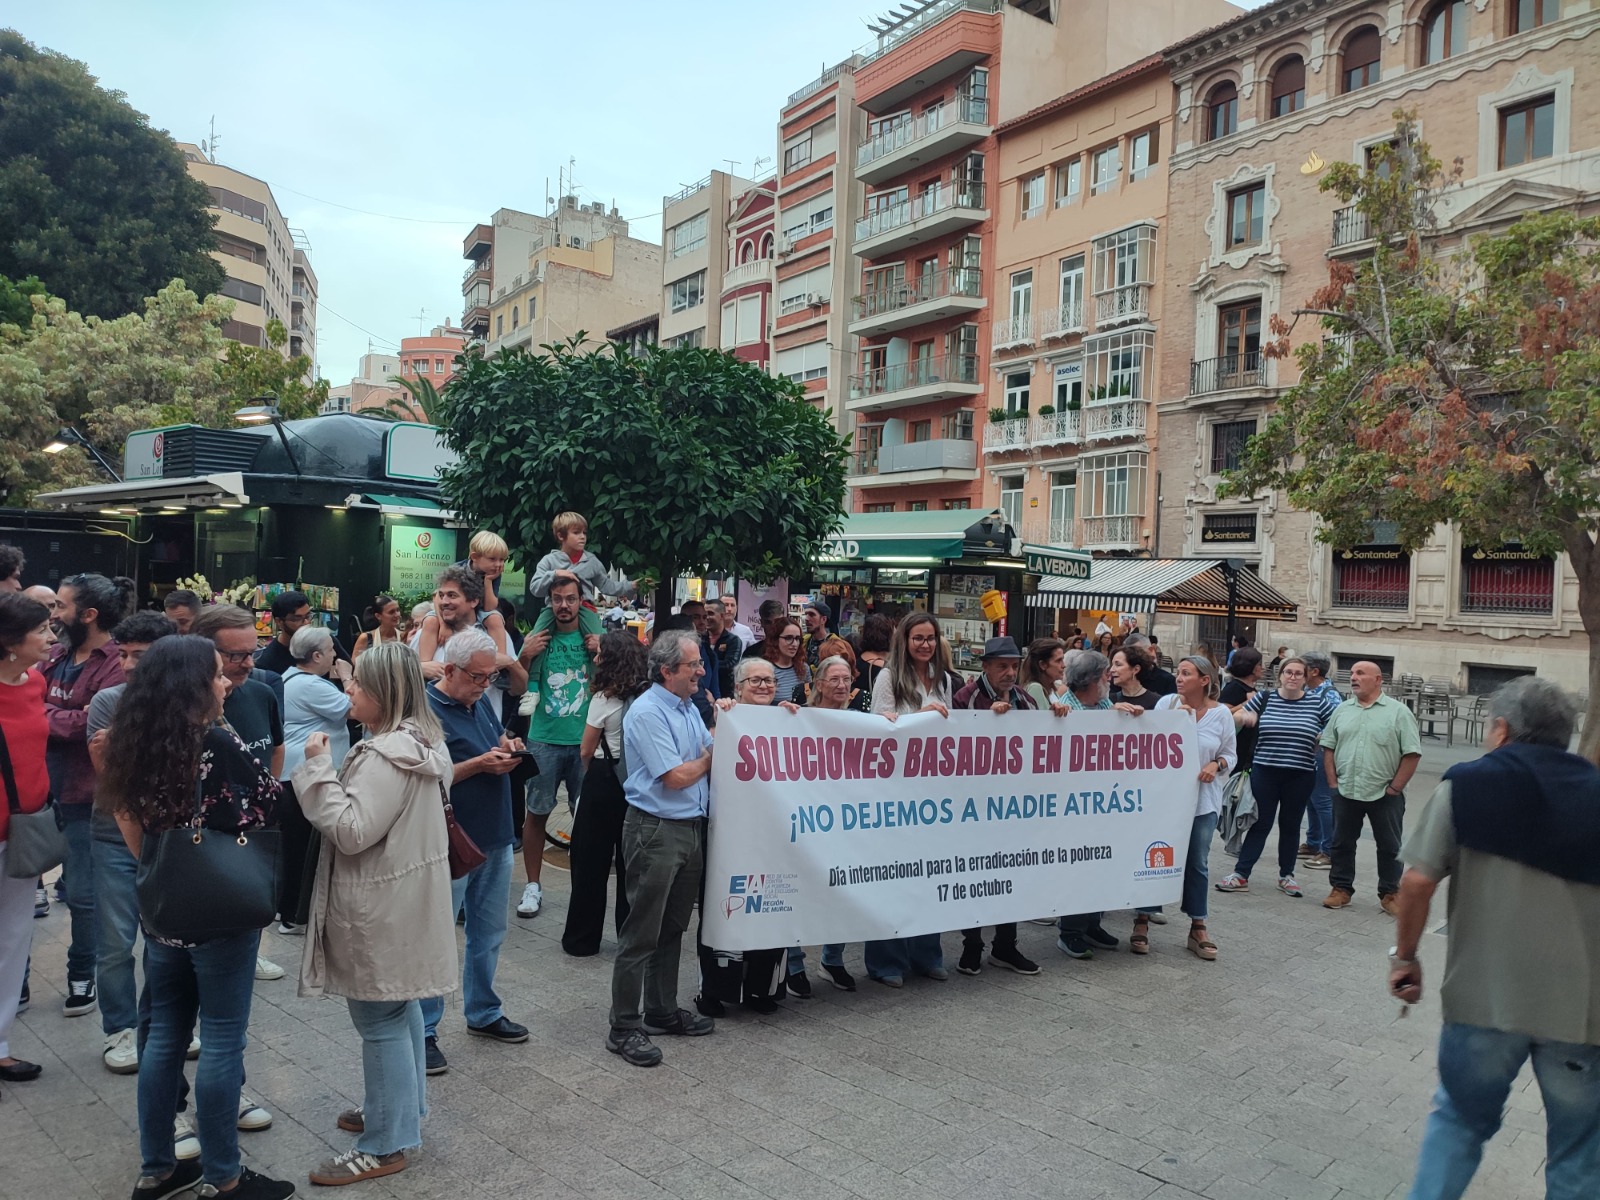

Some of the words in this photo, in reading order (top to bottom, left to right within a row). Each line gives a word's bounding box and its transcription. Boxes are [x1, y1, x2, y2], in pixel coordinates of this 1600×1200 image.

[1056, 364, 1080, 376] aselec
[1213, 531, 1250, 540] Santander
[395, 549, 412, 559] San
[415, 550, 451, 561] Lorenzo
[1353, 550, 1400, 559] Santander
[1027, 555, 1044, 573] LA
[1044, 557, 1088, 578] VERDAD
[735, 734, 898, 782] SOLUCIONES
[903, 735, 1023, 778] BASADAS
[1032, 735, 1063, 774] EN
[1069, 733, 1184, 772] DERECHOS
[790, 804, 834, 843] ¡NO
[841, 798, 953, 831] DEJEMOS
[961, 797, 979, 823] A
[987, 793, 1057, 821] NADIE
[1063, 783, 1143, 816] ATRÁS!
[829, 866, 847, 887] Día
[848, 858, 923, 885] internacional
[926, 859, 952, 878] para
[954, 856, 966, 873] la
[969, 848, 1039, 872] erradicación
[1042, 848, 1054, 864] de
[1058, 847, 1068, 864] la
[1070, 845, 1112, 864] pobreza
[937, 884, 949, 902] 17
[952, 883, 966, 900] de
[970, 879, 1012, 898] octubre
